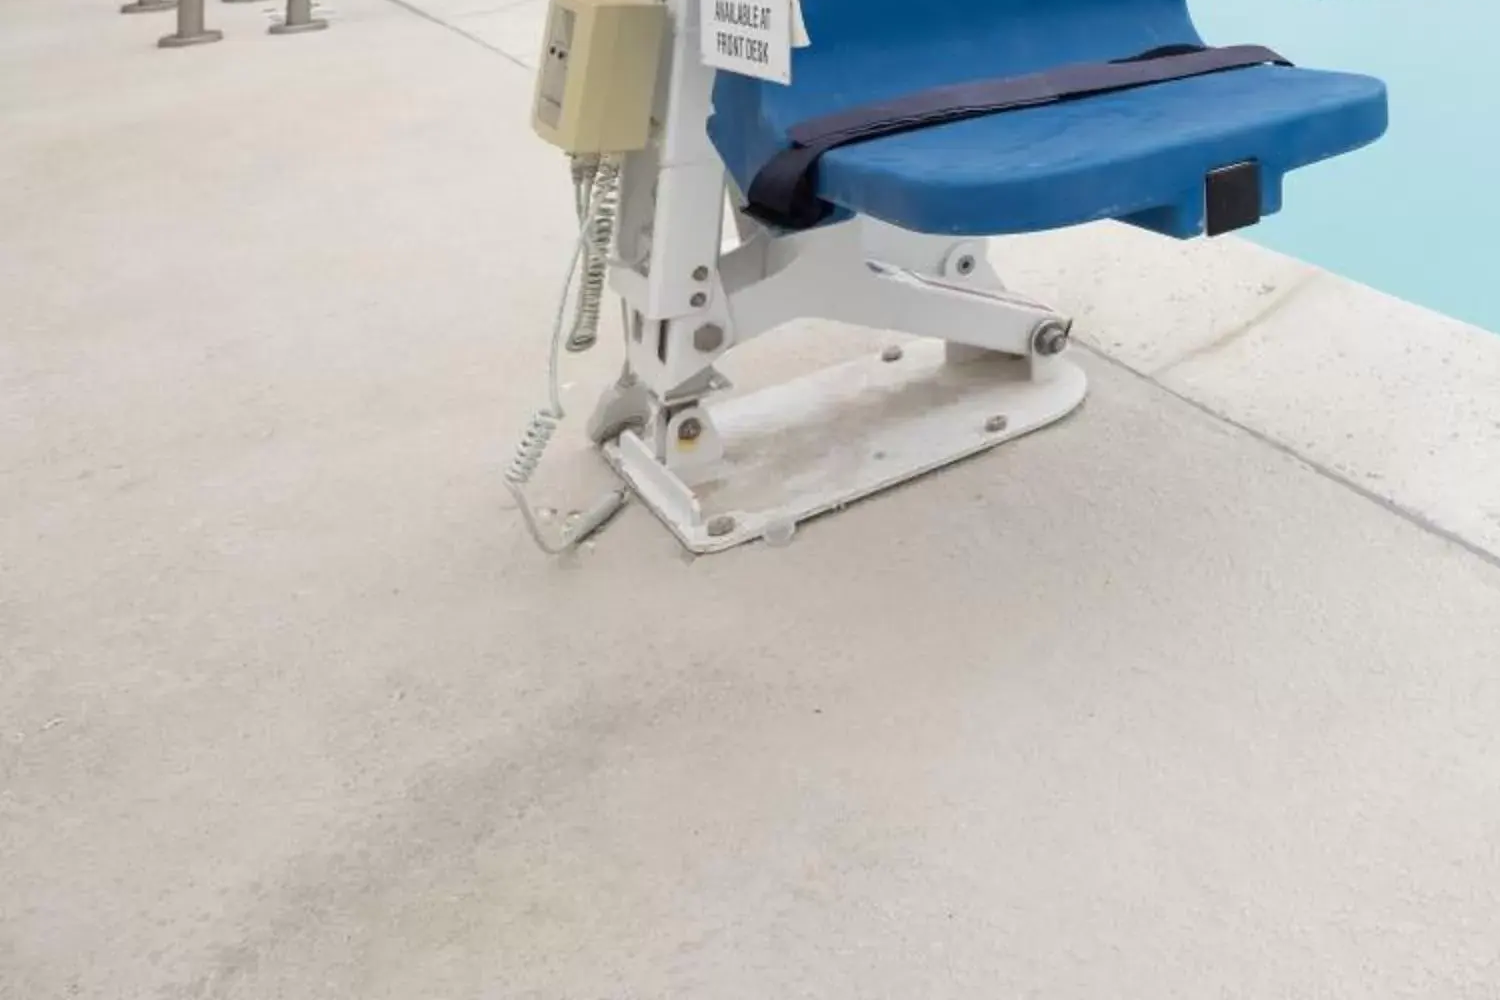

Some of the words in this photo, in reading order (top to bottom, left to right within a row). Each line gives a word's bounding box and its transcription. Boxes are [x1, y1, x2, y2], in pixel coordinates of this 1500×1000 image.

[714, 0, 758, 29] AVAILABLE
[760, 7, 771, 31] AT
[717, 31, 744, 58] FRONT
[746, 37, 768, 64] DESK
